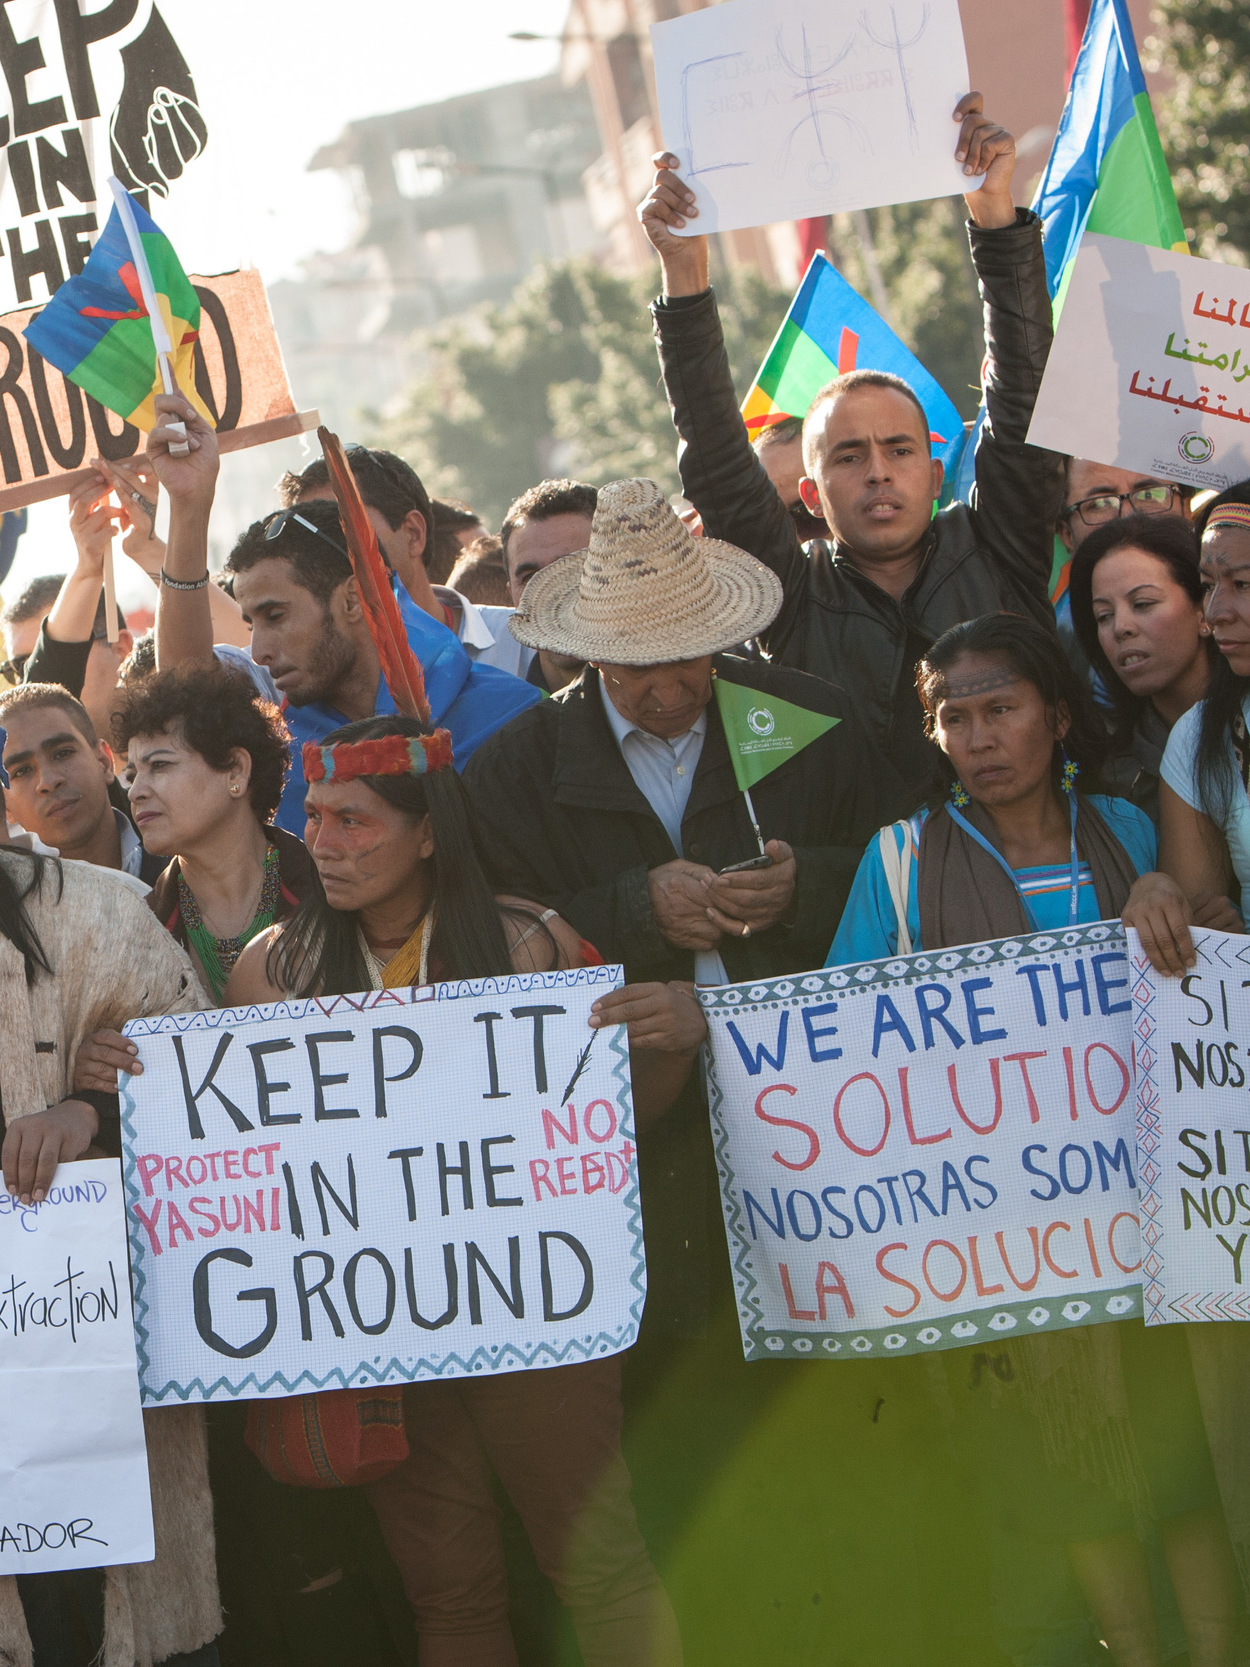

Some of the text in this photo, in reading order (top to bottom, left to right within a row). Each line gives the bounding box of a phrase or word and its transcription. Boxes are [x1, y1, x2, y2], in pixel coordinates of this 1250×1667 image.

[7, 127, 98, 217] IN
[1164, 332, 1250, 383] رامتنا
[1192, 291, 1250, 328] المنا
[726, 952, 1132, 1075] WE ARE THE
[171, 1004, 566, 1140] KEEP IT
[754, 1038, 1136, 1171] SOLUTIO
[1170, 1038, 1250, 1093] NOS
[136, 1142, 280, 1196] PROTECT
[541, 1099, 618, 1150] NO
[132, 1187, 280, 1257] YASUNI
[282, 1134, 524, 1241] IN THE
[742, 1137, 1137, 1242] NOSOTRAS SOM
[193, 1231, 594, 1360] GROUND
[779, 1211, 1142, 1321] LA SOLUCIO
